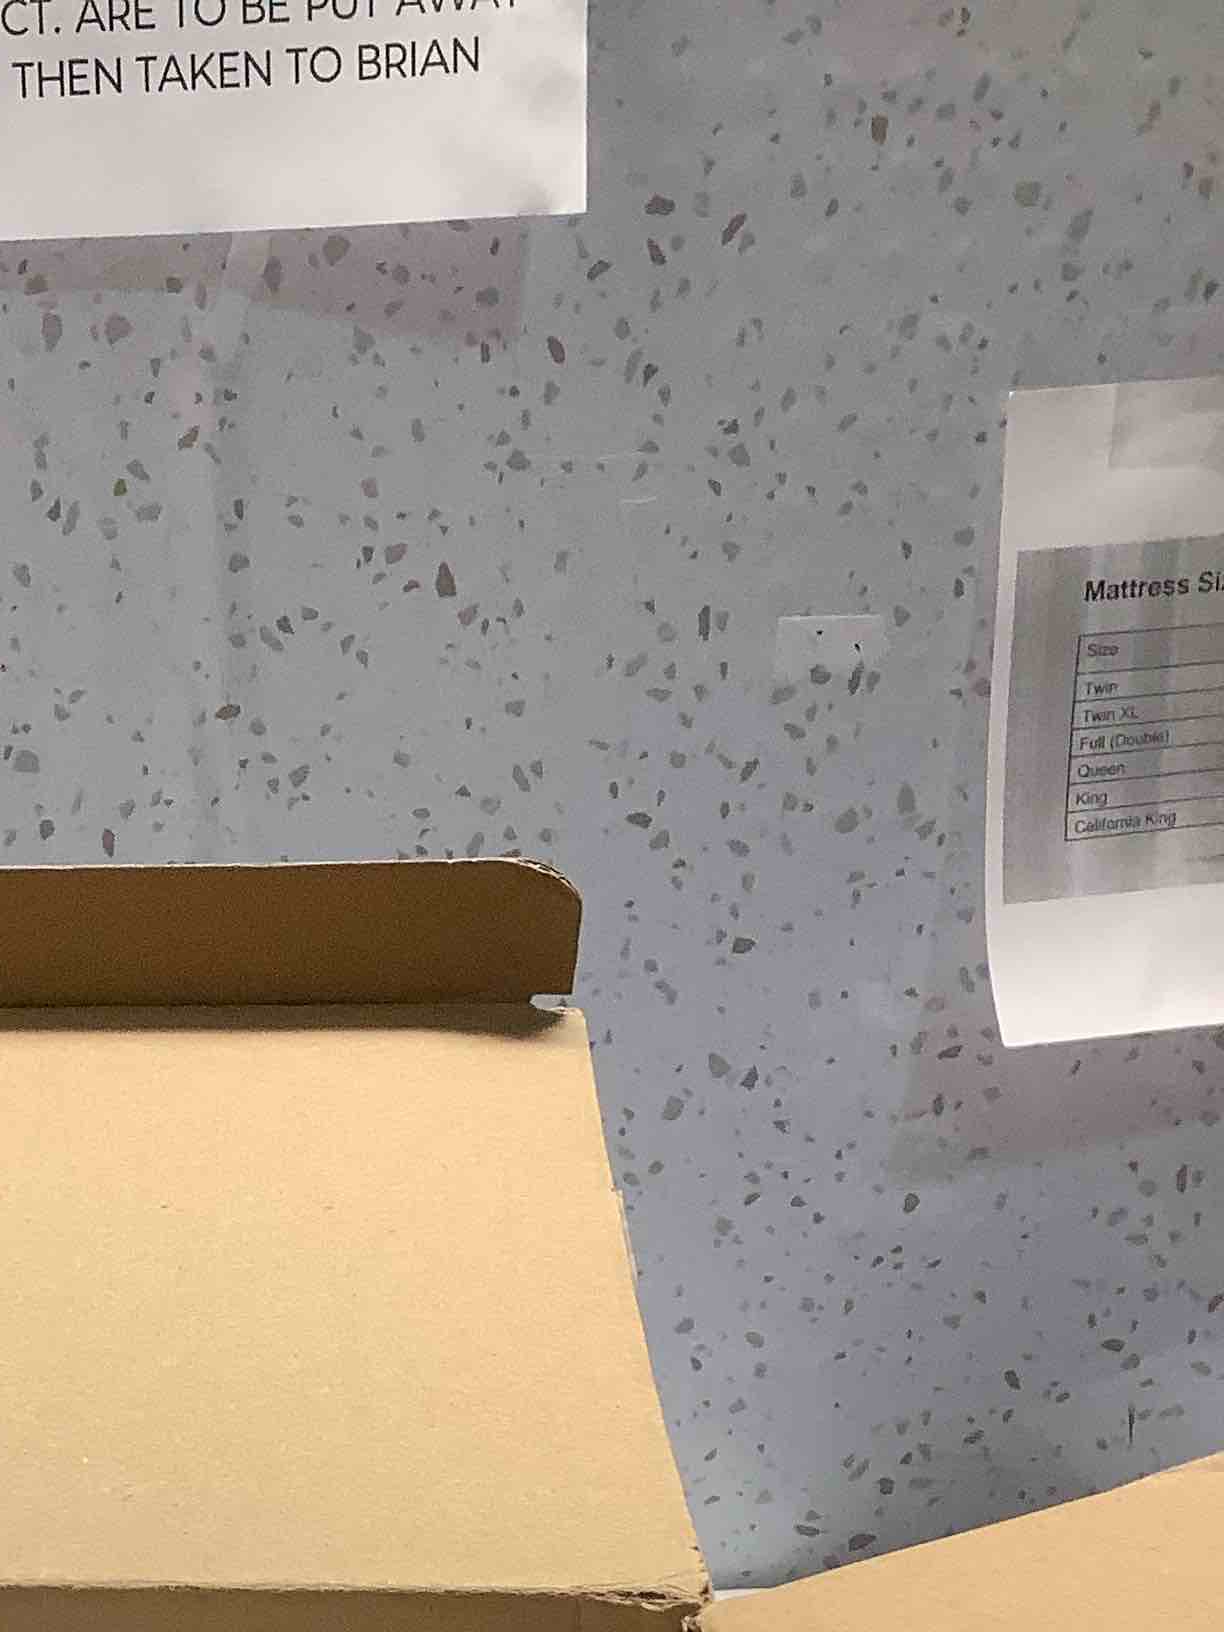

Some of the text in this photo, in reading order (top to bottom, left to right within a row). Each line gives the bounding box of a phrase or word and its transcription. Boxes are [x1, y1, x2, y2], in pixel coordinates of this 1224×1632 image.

[75, 0, 156, 33] ARE
[176, 0, 226, 28] TO
[242, 0, 290, 25] BE
[11, 35, 479, 99] THEN TAKEN TO BRIAN
[1084, 570, 1224, 602] Mattress Si
[1084, 707, 1116, 722] Twin
[1080, 730, 1170, 751] Full (Double)
[1078, 763, 1125, 778] Queen
[1076, 791, 1108, 807] King
[1074, 810, 1176, 834] California King
